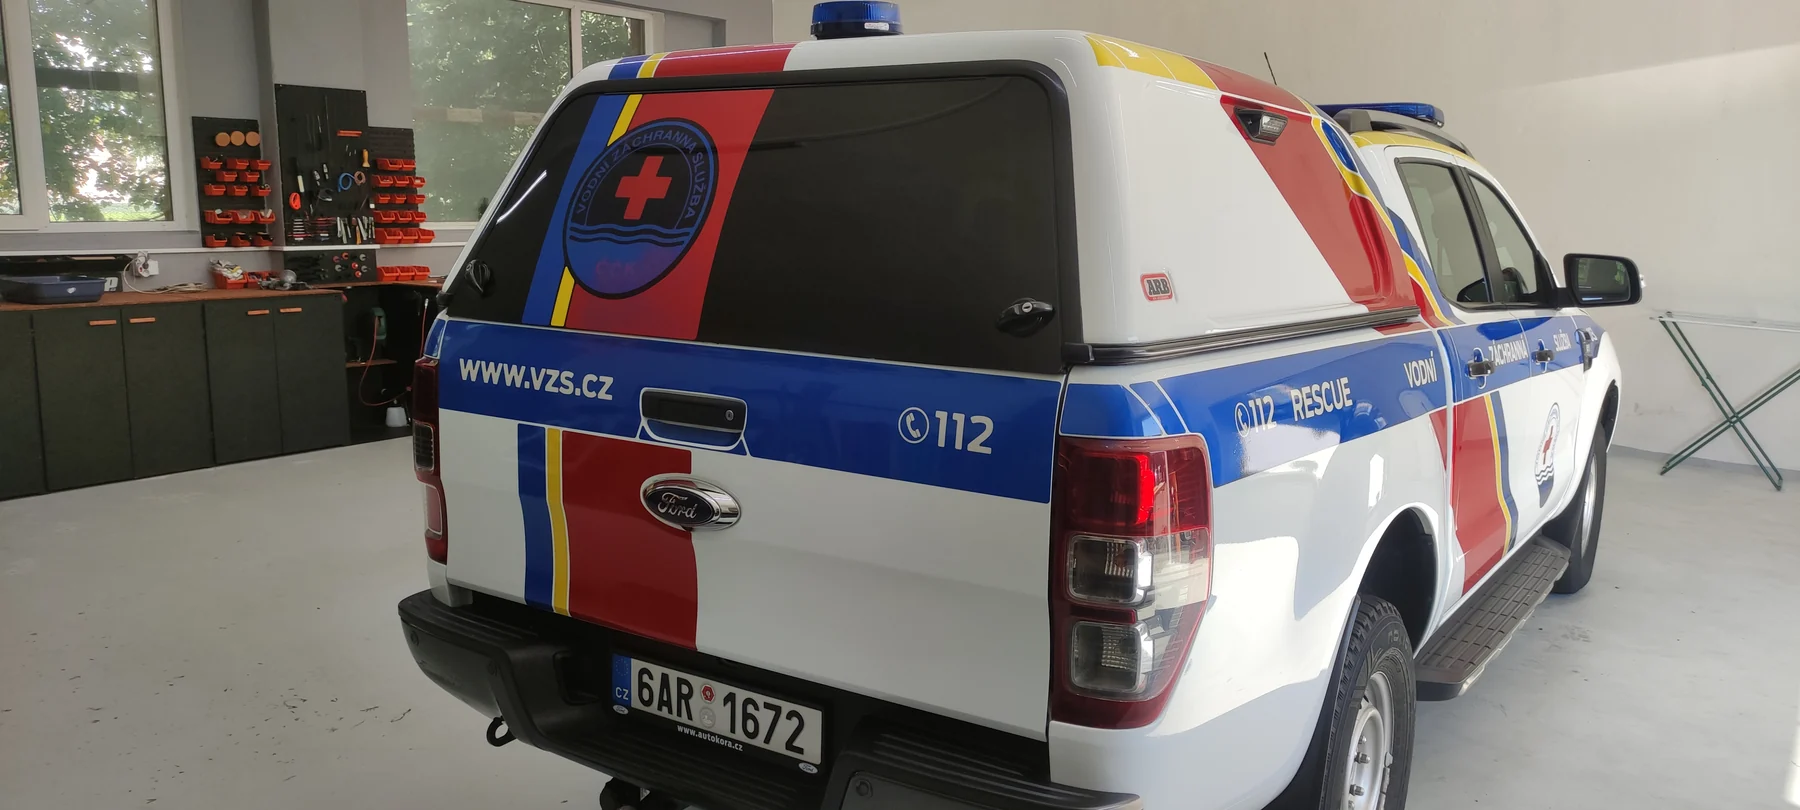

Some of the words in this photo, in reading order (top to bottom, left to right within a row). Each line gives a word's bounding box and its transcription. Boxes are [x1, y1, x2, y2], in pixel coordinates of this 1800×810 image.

[1146, 279, 1170, 295] ARB
[459, 358, 614, 400] WWW.VZS.CZ
[1248, 395, 1277, 433] 112
[1290, 376, 1353, 422] RESCUE
[1403, 350, 1438, 388] VODNÍ
[935, 410, 994, 455] 112
[657, 492, 698, 519] Ford
[615, 686, 629, 700] CZ
[637, 667, 694, 721] 6AR
[723, 692, 805, 755] 1672
[677, 725, 743, 751] www.autokora.cz
